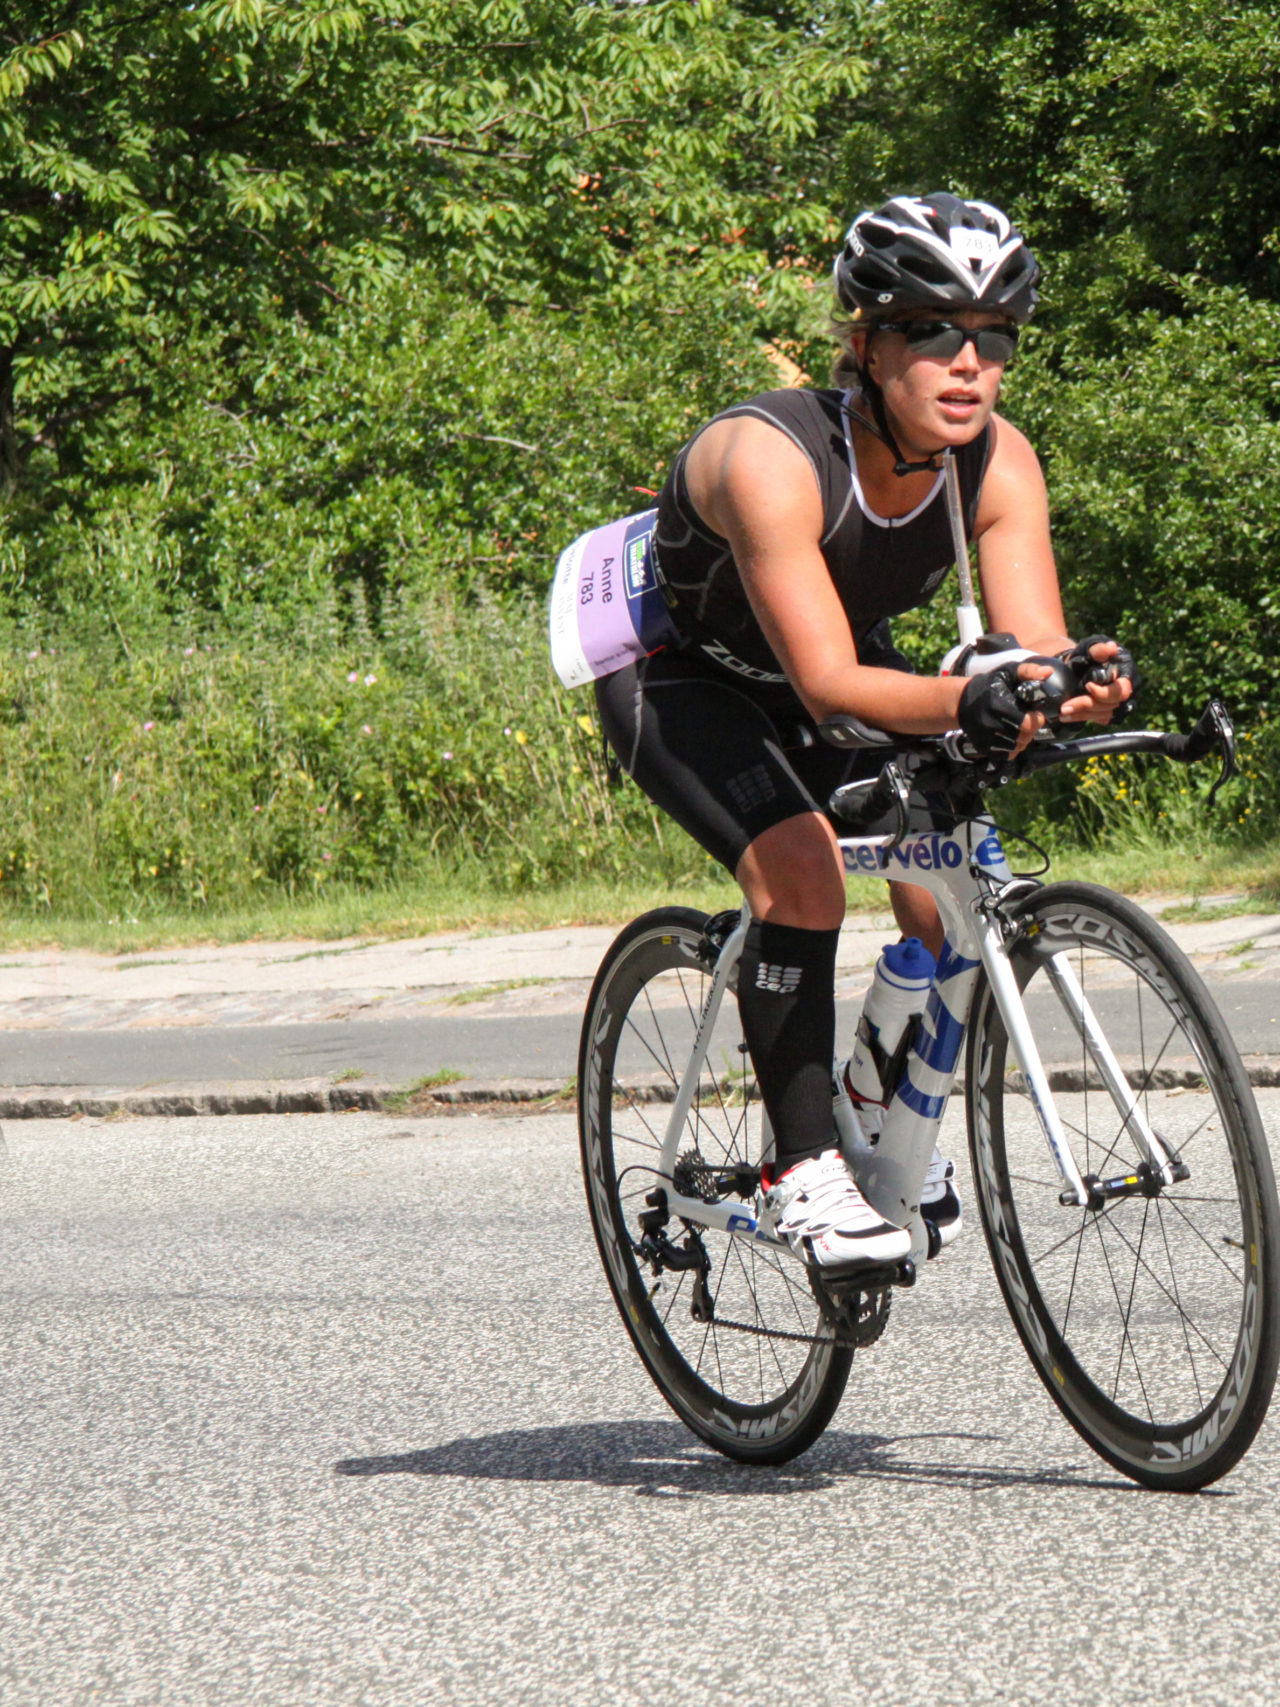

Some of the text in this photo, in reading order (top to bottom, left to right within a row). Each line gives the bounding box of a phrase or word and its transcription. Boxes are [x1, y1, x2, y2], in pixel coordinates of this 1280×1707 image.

[580, 571, 594, 605] 783
[601, 557, 615, 604] Anne
[844, 834, 963, 871] cervélo
